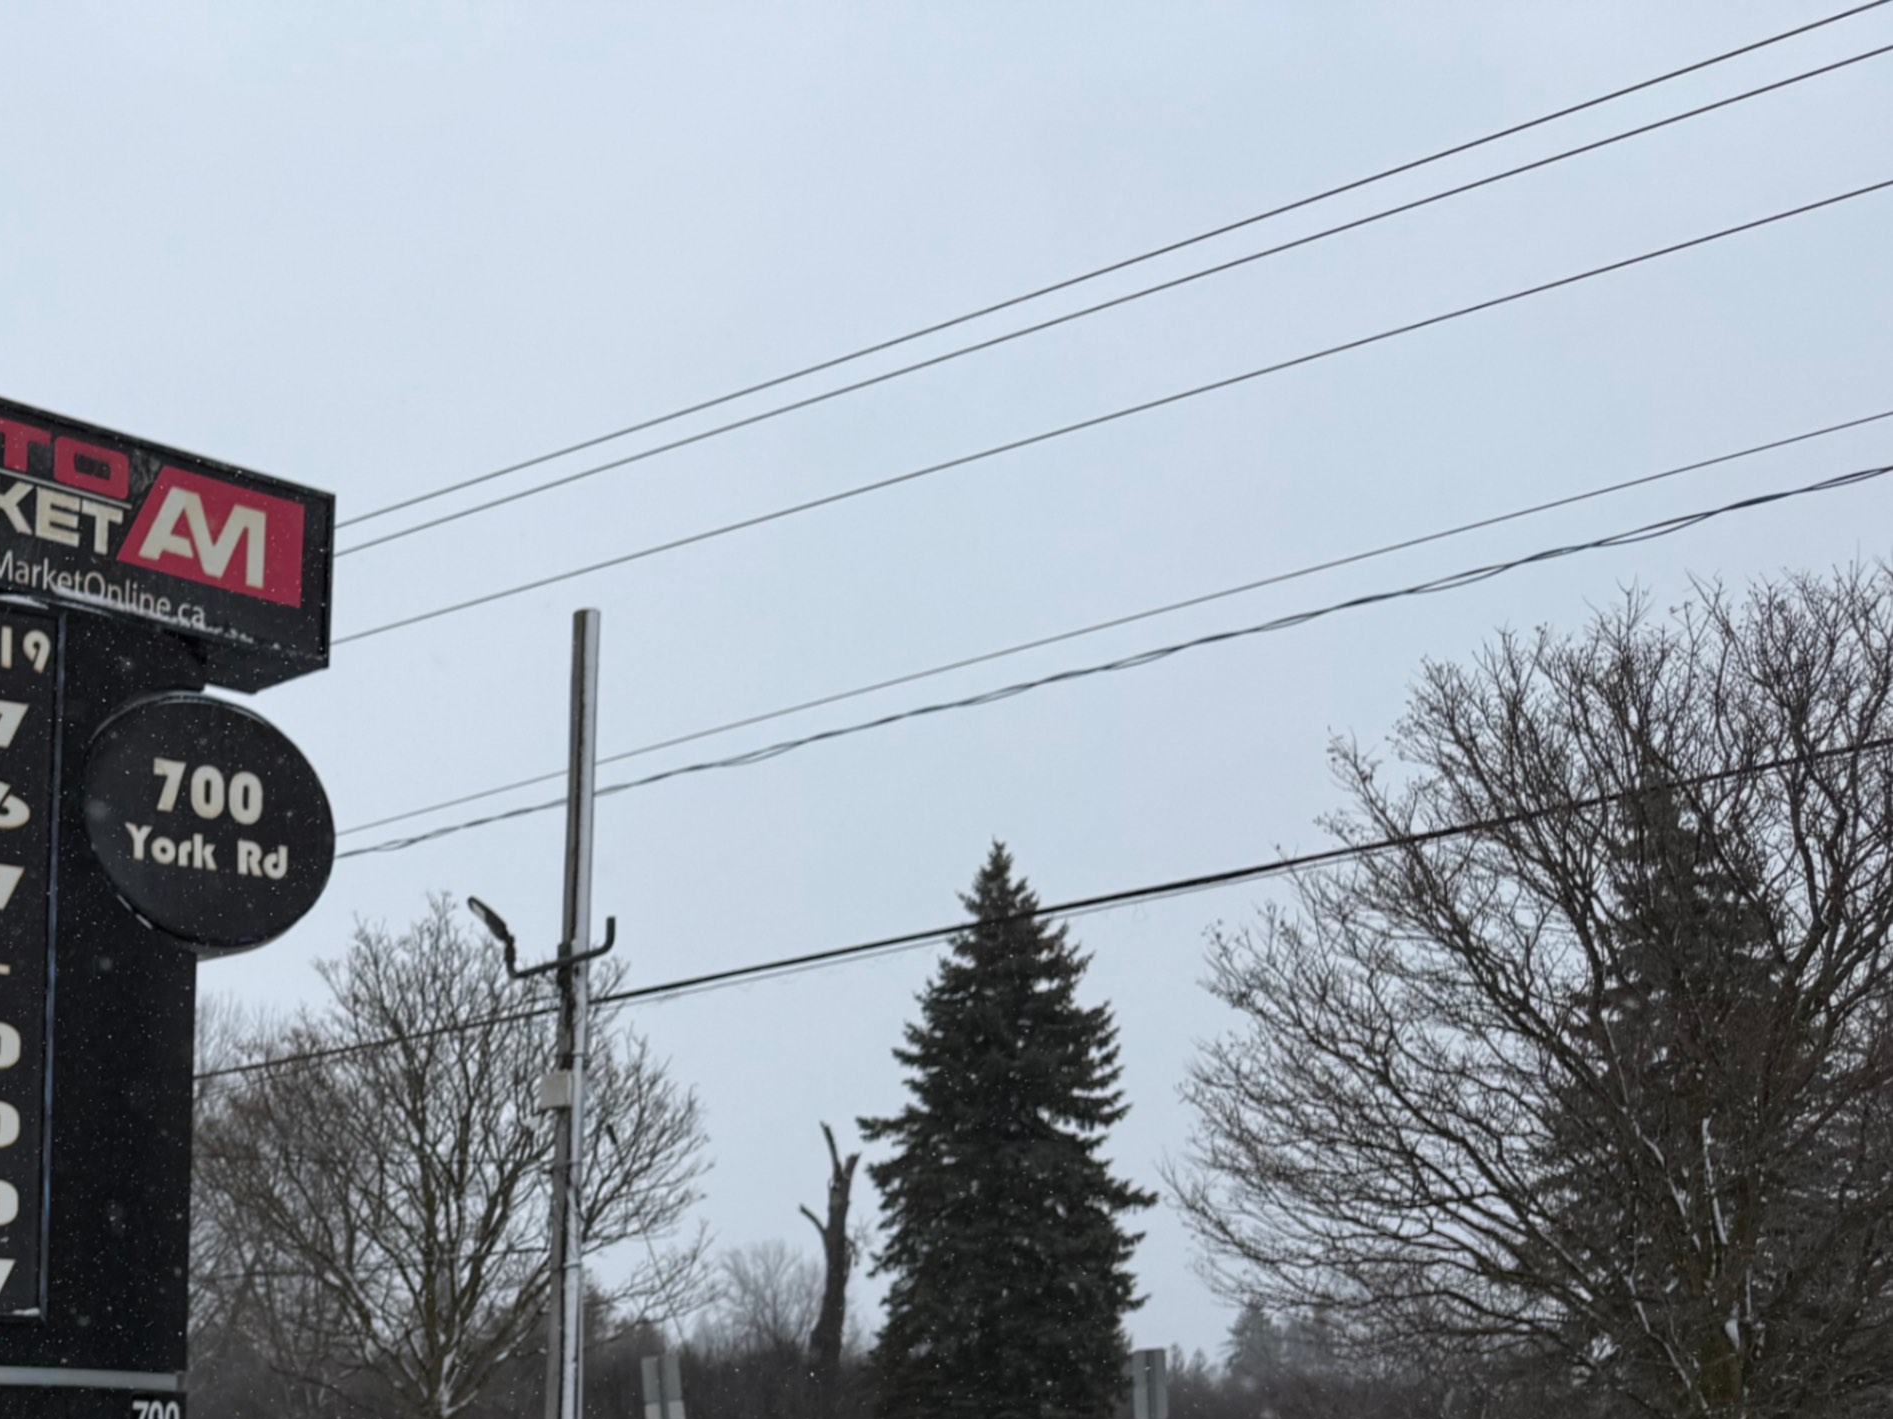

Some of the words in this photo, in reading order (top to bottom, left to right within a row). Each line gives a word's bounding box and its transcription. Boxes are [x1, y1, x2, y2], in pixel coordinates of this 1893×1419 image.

[137, 486, 267, 589] AM
[153, 756, 264, 826] 700
[125, 821, 217, 871] York
[237, 838, 288, 880] Rd
